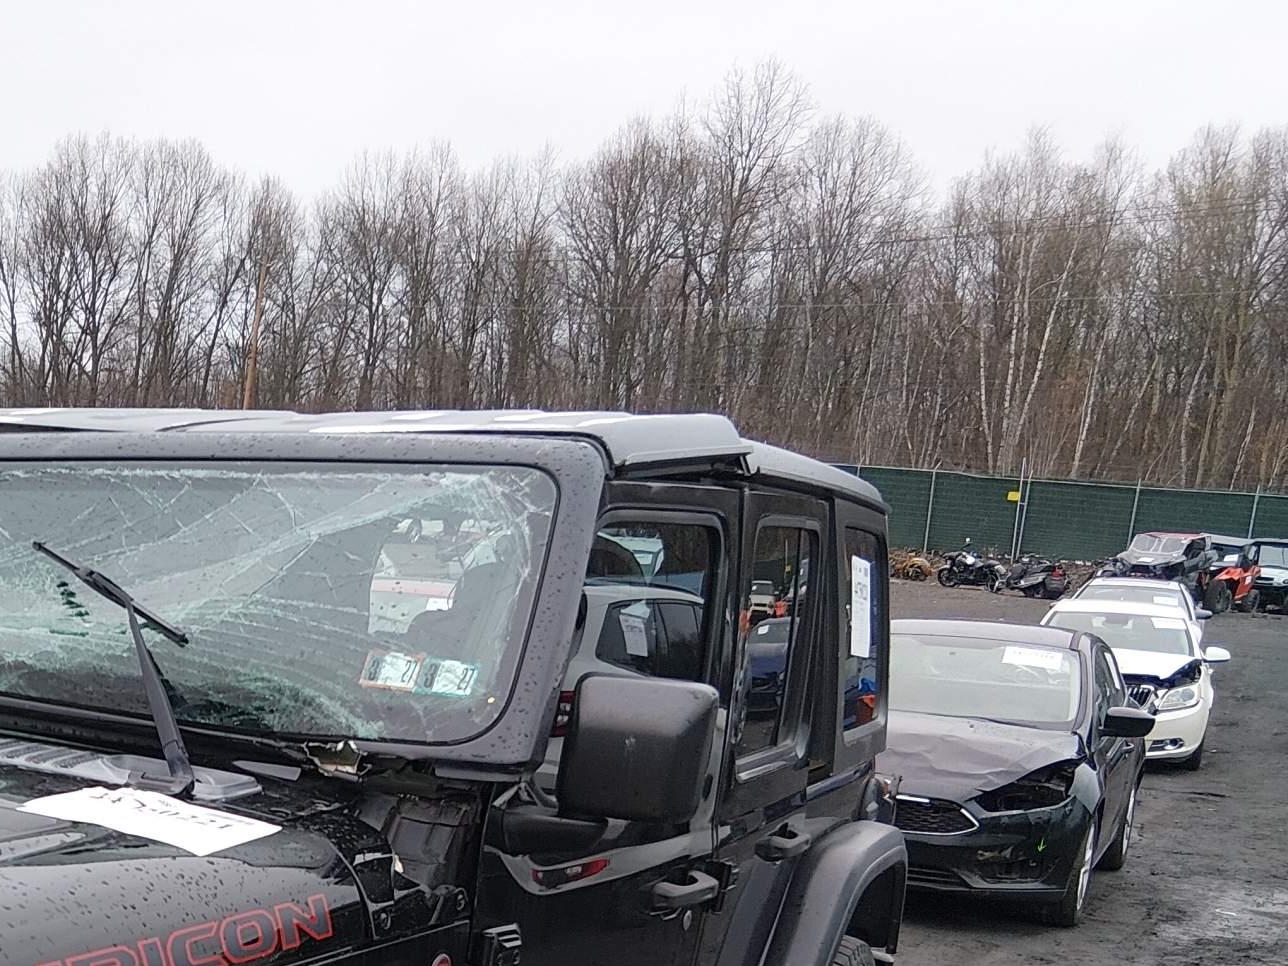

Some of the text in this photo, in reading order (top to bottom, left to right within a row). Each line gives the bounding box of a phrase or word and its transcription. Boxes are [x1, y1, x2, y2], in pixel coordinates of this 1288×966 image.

[400, 660, 418, 684] 27
[423, 662, 476, 693] 3 27
